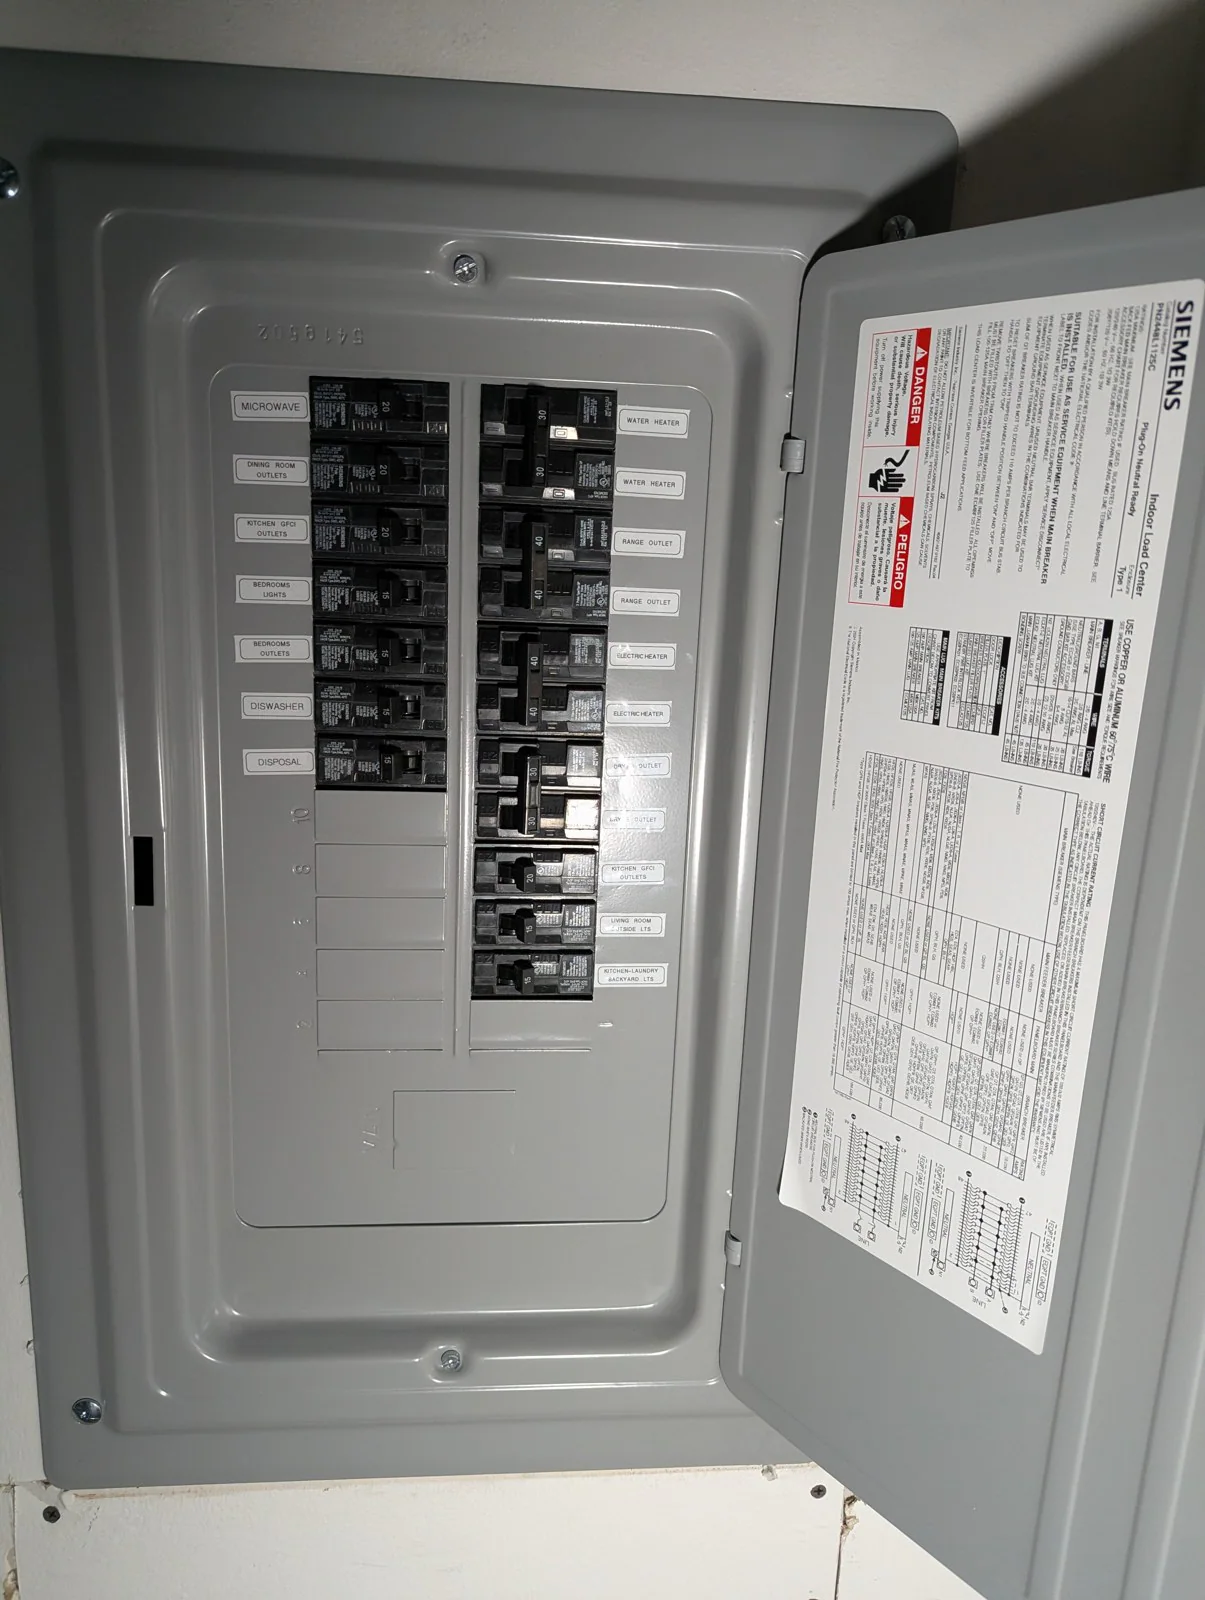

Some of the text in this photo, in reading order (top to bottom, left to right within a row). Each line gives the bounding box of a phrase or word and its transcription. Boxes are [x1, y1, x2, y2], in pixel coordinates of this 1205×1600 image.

[1066, 312, 1073, 321] IS
[904, 334, 912, 368] Hazardous
[1060, 323, 1072, 371] INSTALLED.
[1164, 300, 1193, 409] SIEMENS
[910, 366, 924, 423] DANGER
[241, 403, 300, 412] MICROWAVE
[382, 402, 390, 412] 20
[538, 410, 547, 420] 30
[1040, 311, 1081, 584] SUITABLE FOR USE AS SERVICE EQUIPMENT WHEN MAIN BREAKER
[380, 465, 387, 475] 20
[536, 467, 544, 477] 30
[1127, 421, 1148, 516] Plug-On Neutral Ready
[382, 528, 389, 538] 20
[535, 536, 543, 546] 40
[1135, 493, 1159, 596] Indoor Load Center
[893, 534, 907, 589] PELIGRO
[1116, 566, 1126, 585] Type
[1125, 564, 1134, 594] Enclosure
[535, 590, 543, 600] 40
[1124, 618, 1134, 635] USE
[382, 649, 388, 658] 15
[1099, 637, 1108, 667] TERMINALS
[1119, 637, 1131, 670] COPPER
[530, 656, 538, 667] 40
[1117, 672, 1126, 685] OR
[250, 702, 304, 711] DISWASHER
[383, 708, 389, 716] 15
[530, 707, 538, 717] 40
[1111, 687, 1123, 728] ALUMINUM
[384, 756, 391, 764] 15
[1083, 750, 1092, 772] TORQUE
[530, 768, 537, 777] 30
[1102, 763, 1112, 783] WIRE
[529, 817, 535, 826] 30
[1085, 802, 1106, 907] SHORT CIRCUIT CURRENT RATING
[526, 874, 534, 883] 20
[525, 976, 531, 984] 15
[1024, 1258, 1033, 1284] NEUTRAL
